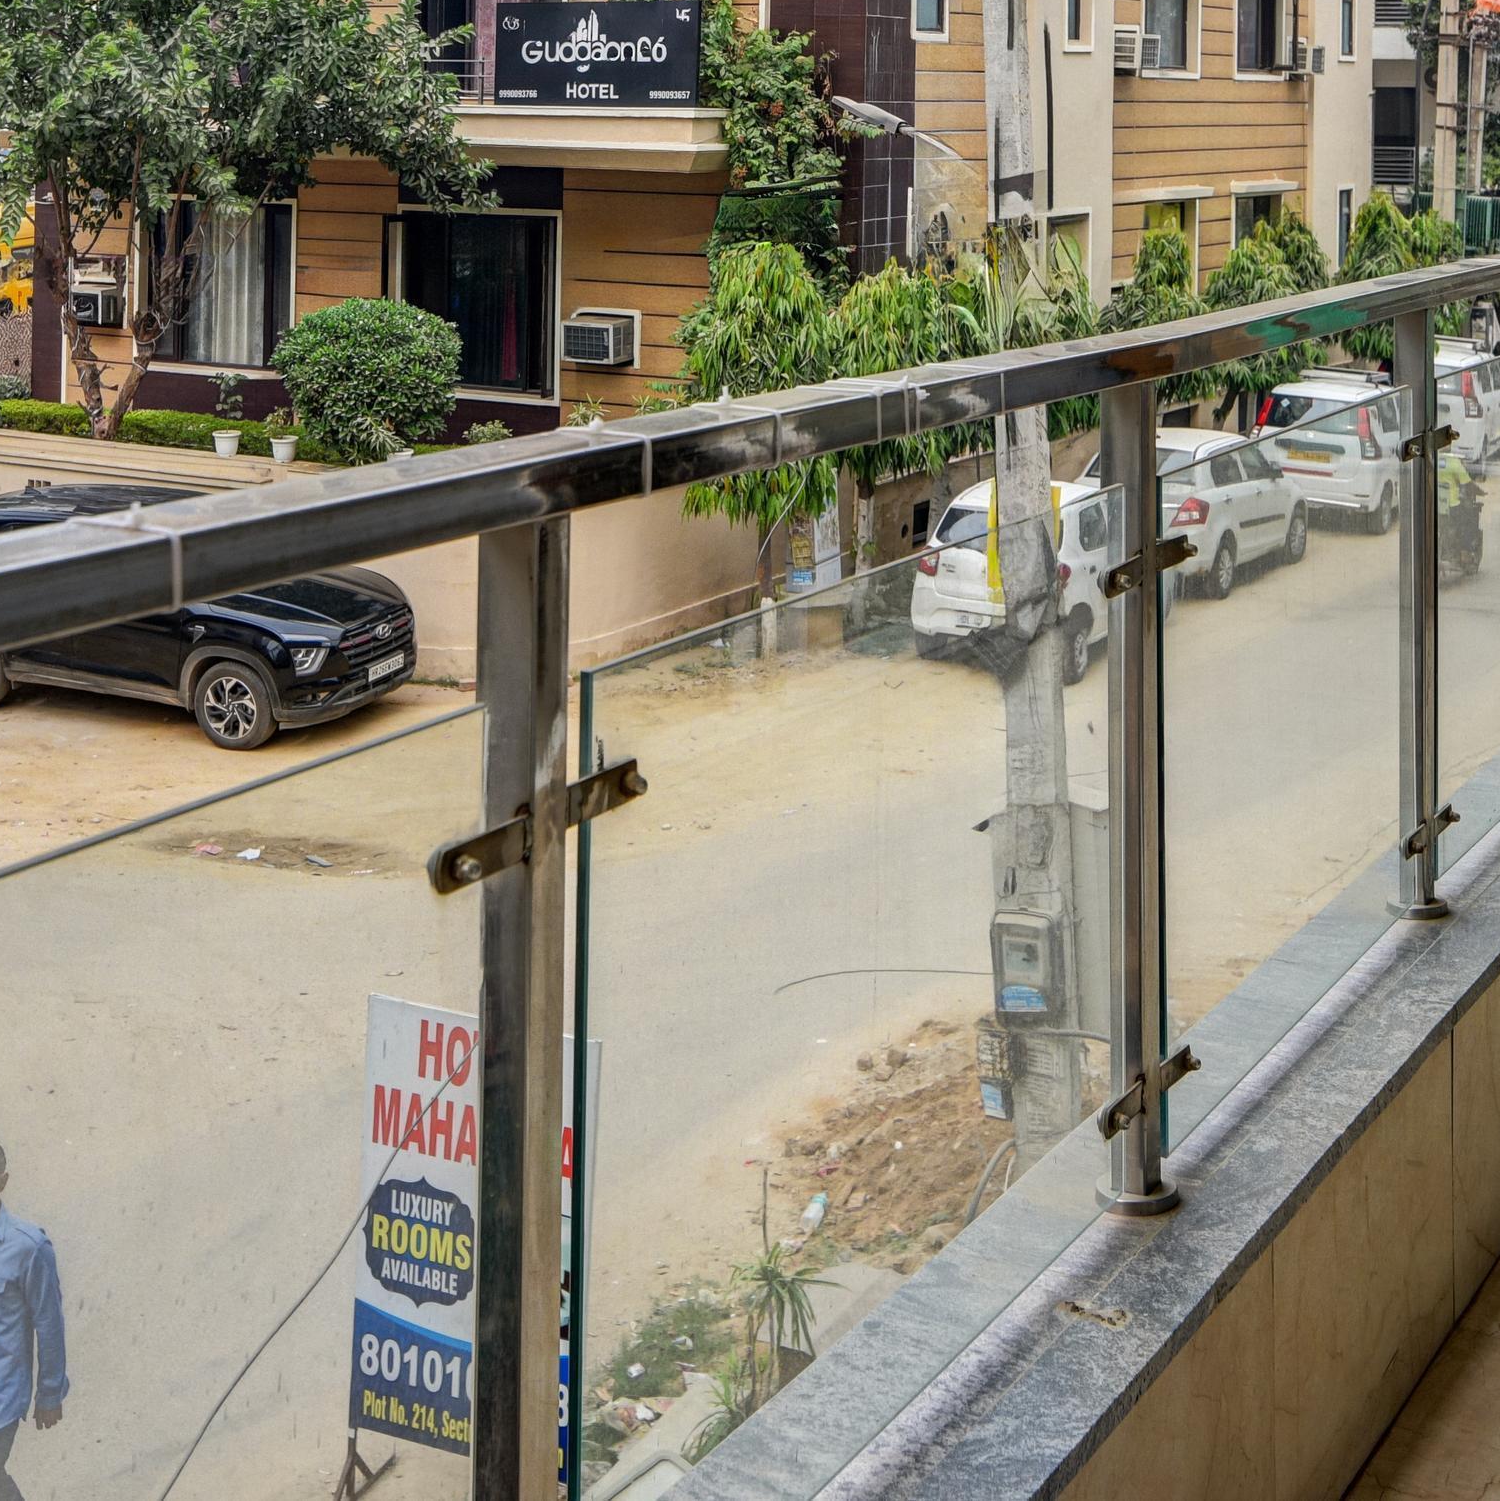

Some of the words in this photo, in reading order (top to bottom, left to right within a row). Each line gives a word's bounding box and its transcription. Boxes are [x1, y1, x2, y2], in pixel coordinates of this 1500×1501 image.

[498, 89, 538, 98] 9990093766
[566, 81, 619, 100] HOTEL
[649, 90, 691, 99] 9990093657
[418, 1019, 479, 1087] HO
[391, 1189, 454, 1226] LUXURY
[372, 1214, 472, 1270] ROOMS
[381, 1257, 459, 1296] AVAILABLE
[363, 1389, 386, 1421] Plot
[389, 1397, 408, 1426] No.
[412, 1403, 438, 1439] 214,
